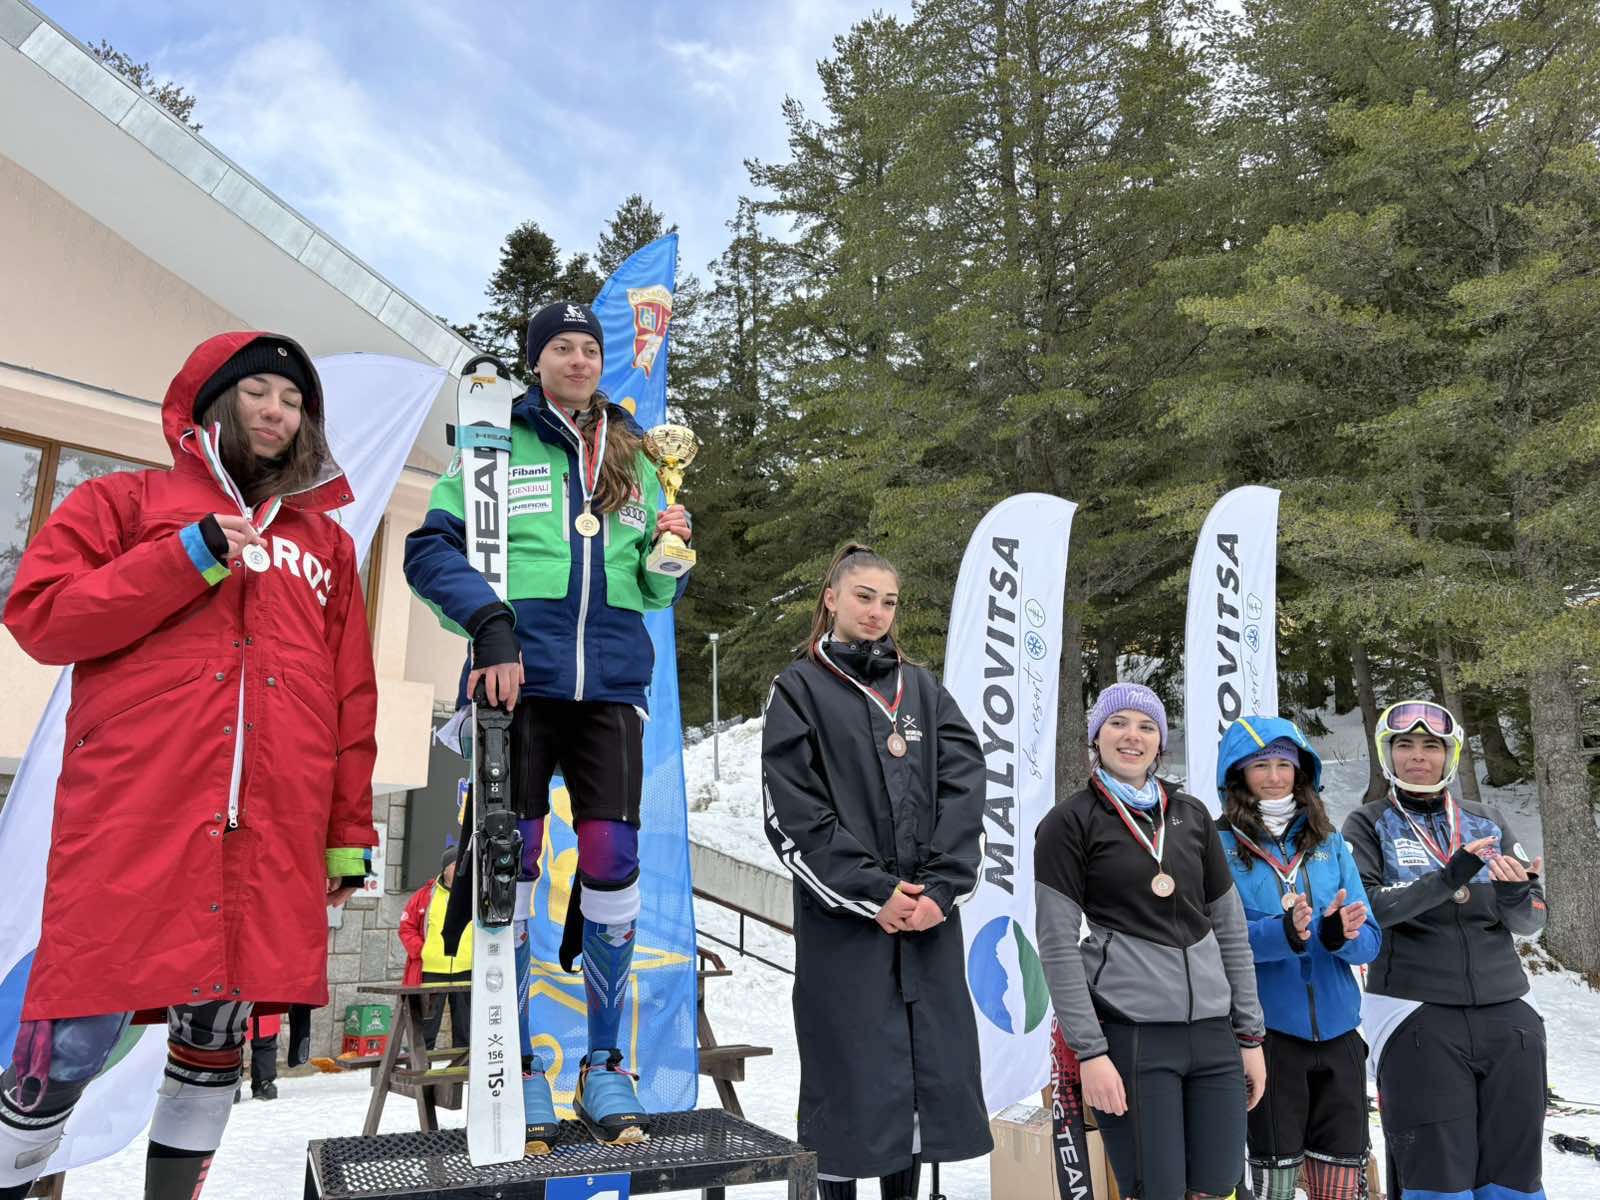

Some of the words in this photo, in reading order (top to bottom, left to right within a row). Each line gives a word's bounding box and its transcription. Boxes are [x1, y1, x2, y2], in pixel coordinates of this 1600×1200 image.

[512, 466, 549, 477] Fibank
[512, 484, 549, 495] GENERALI
[1023, 663, 1044, 735] resort
[983, 536, 1020, 896] MALYOVITSA
[488, 1050, 504, 1060] 156
[488, 1067, 504, 1097] eSL
